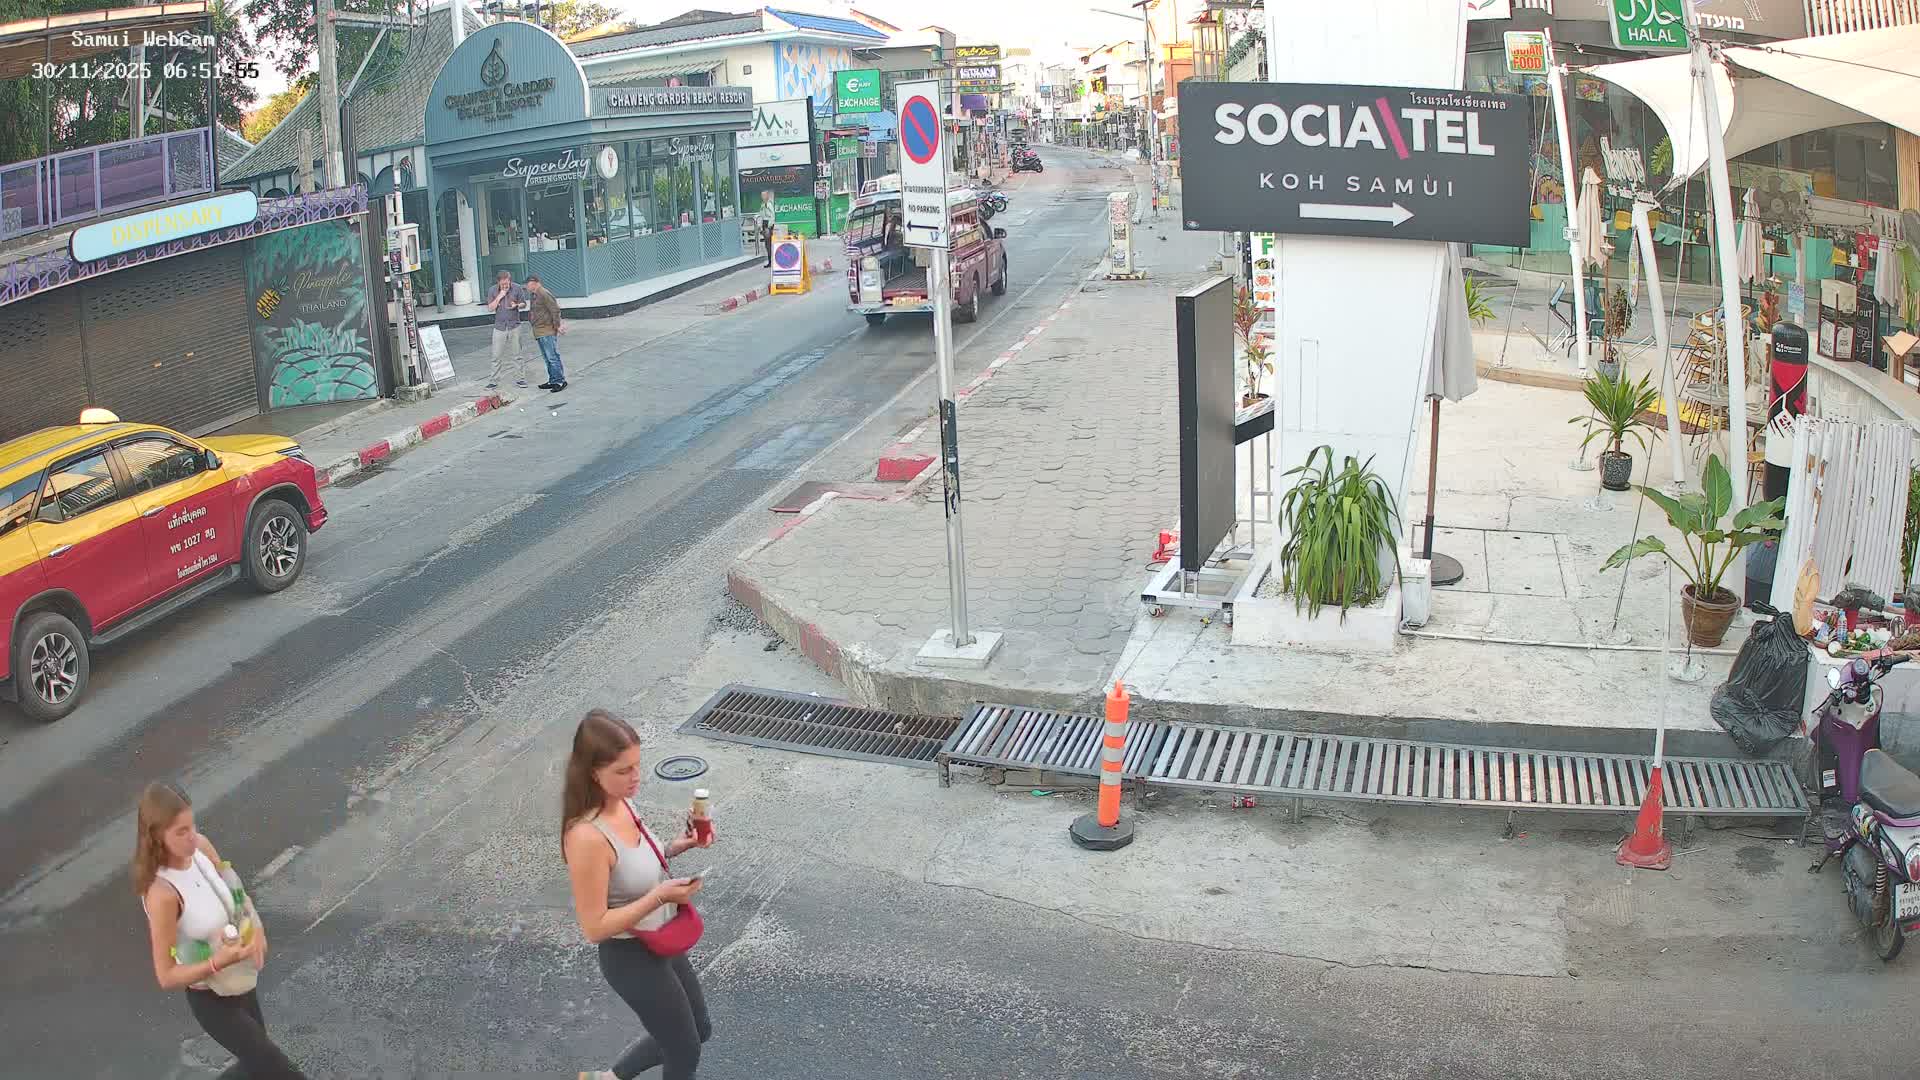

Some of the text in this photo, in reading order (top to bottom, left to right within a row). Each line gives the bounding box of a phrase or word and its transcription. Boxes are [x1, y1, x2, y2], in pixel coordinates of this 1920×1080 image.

[1628, 27, 1677, 43] HALAL
[1513, 56, 1543, 69] FOOD
[503, 77, 556, 96] GARDEN
[611, 91, 746, 107] CHAWENG GARDEN BEACH RESORT
[839, 97, 880, 108] EXCHANGE
[530, 175, 552, 184] GREEN
[1259, 172, 1454, 197] KOH SAMUI
[908, 204, 941, 214] NO PARKING
[112, 205, 224, 247] DISPENSARY
[301, 299, 347, 313] THAILAND
[184, 532, 201, 549] 1027
